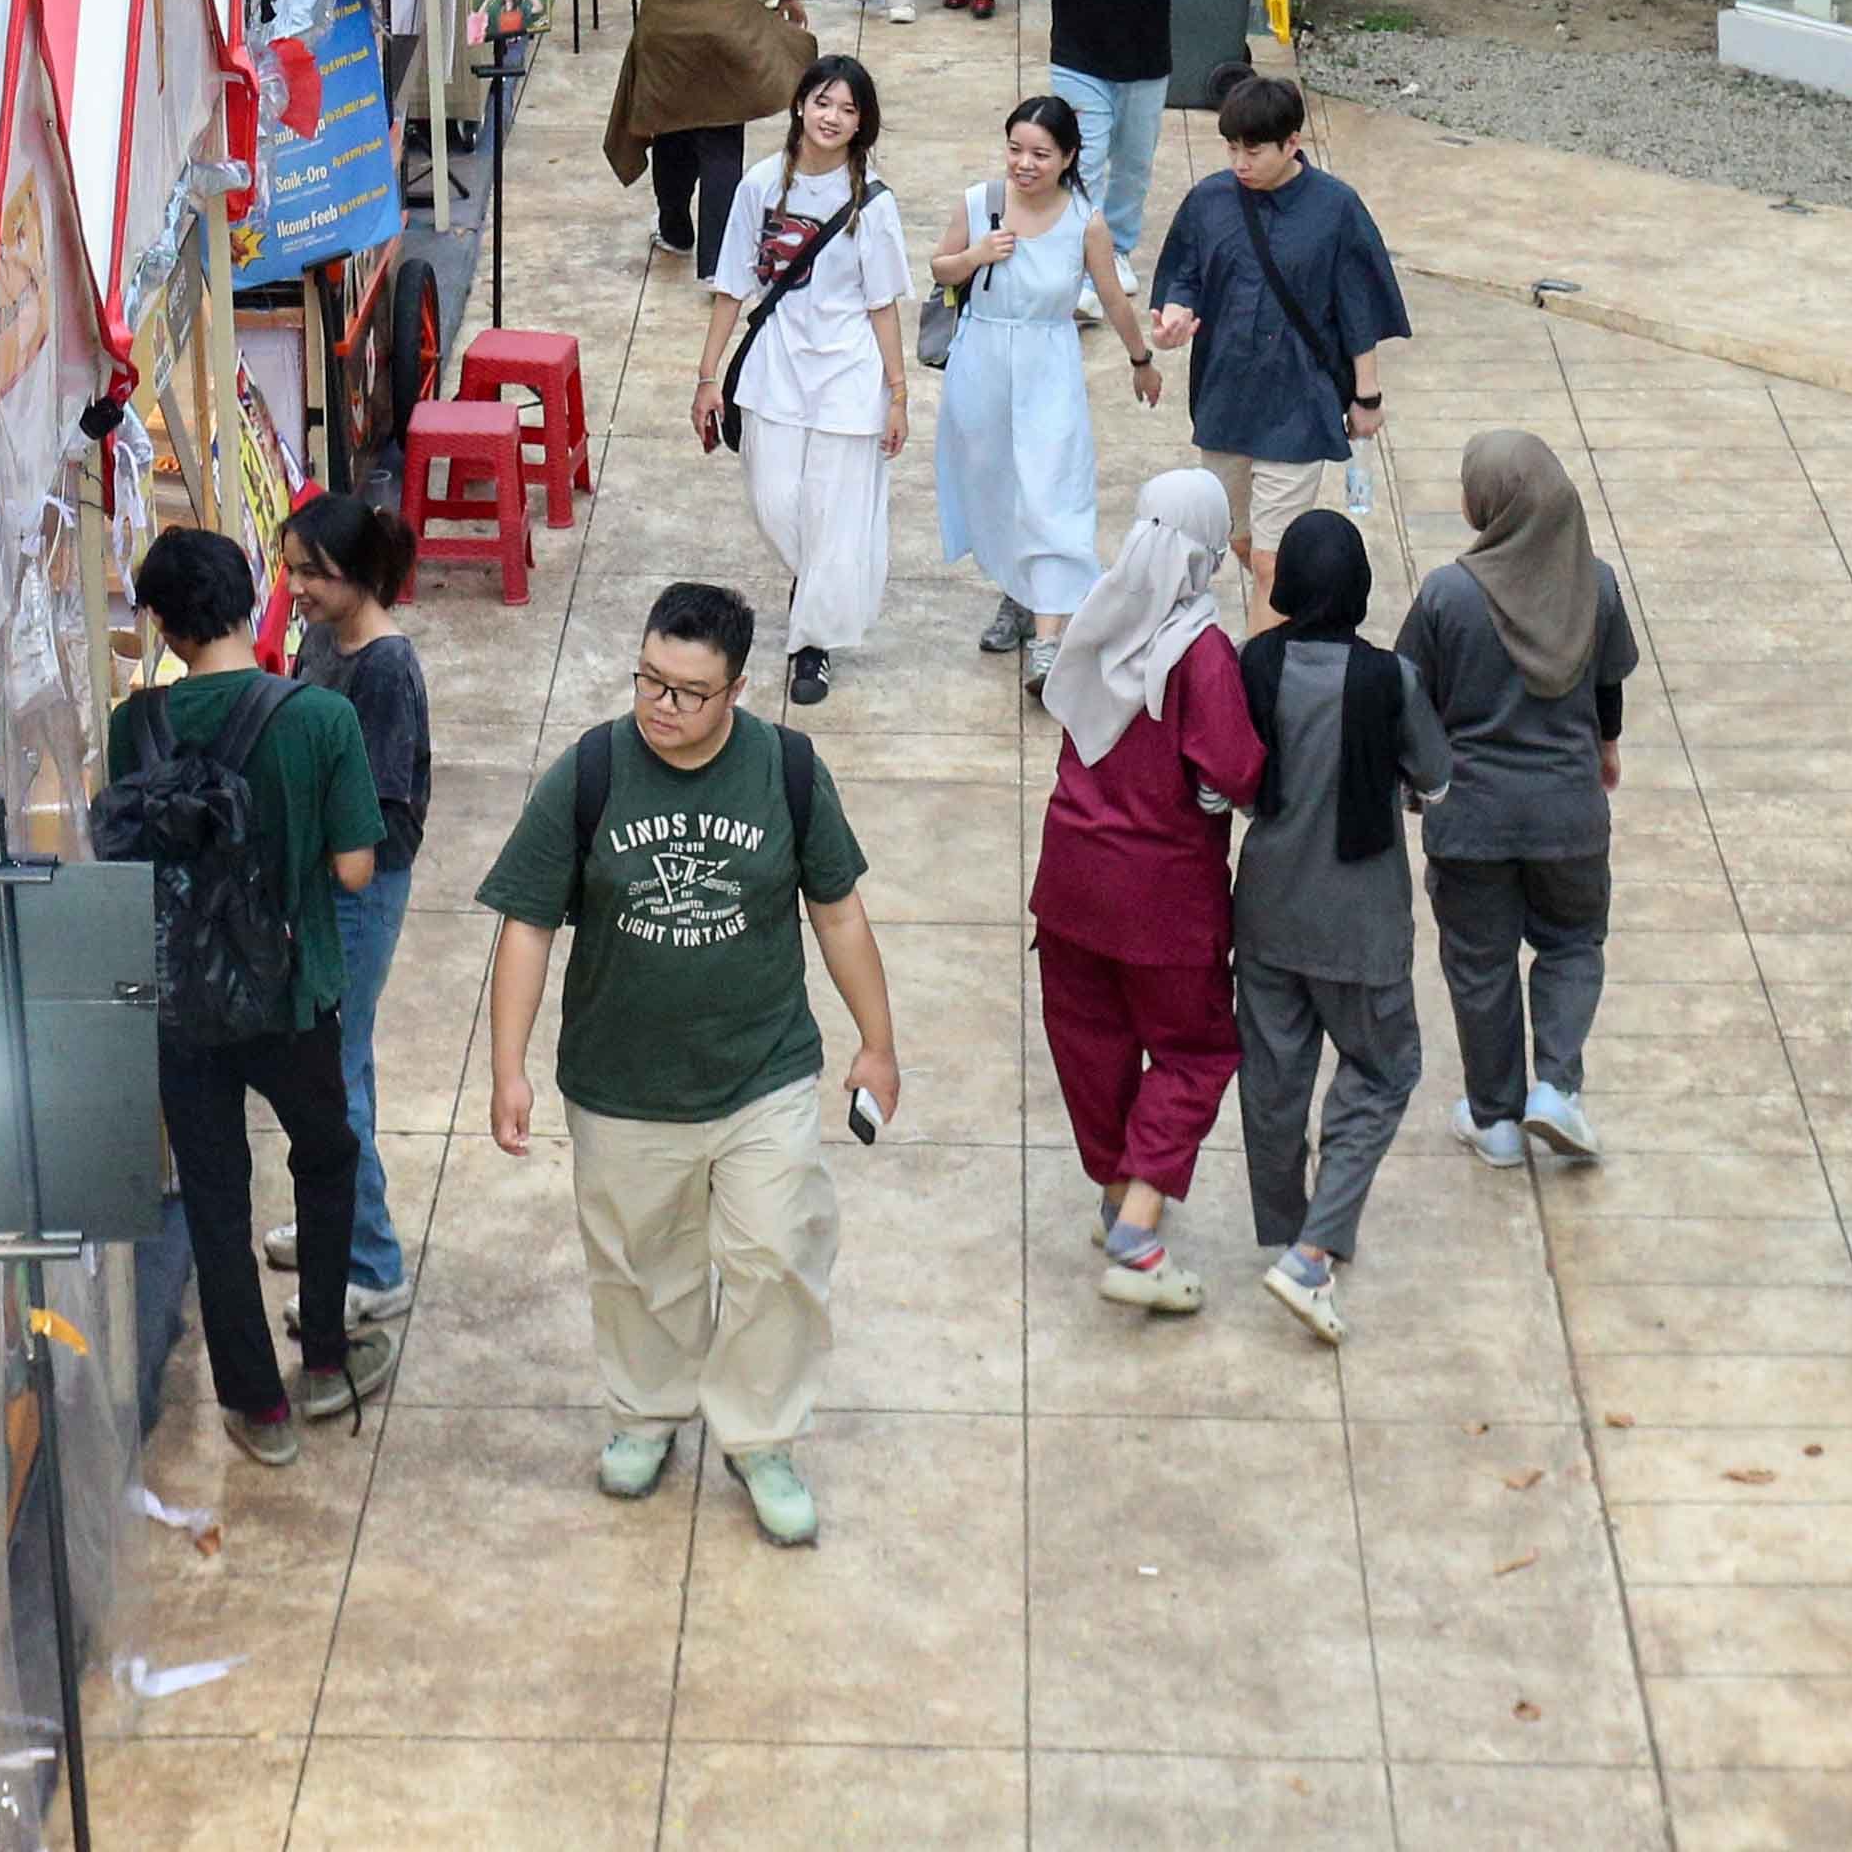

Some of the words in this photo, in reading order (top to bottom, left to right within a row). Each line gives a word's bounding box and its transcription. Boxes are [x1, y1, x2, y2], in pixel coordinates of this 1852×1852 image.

[276, 216, 310, 238] Ikone
[311, 204, 339, 228] Feeb
[609, 812, 688, 854] LINDS
[616, 912, 667, 944] LIGHT
[672, 911, 748, 947] VINTAGE
